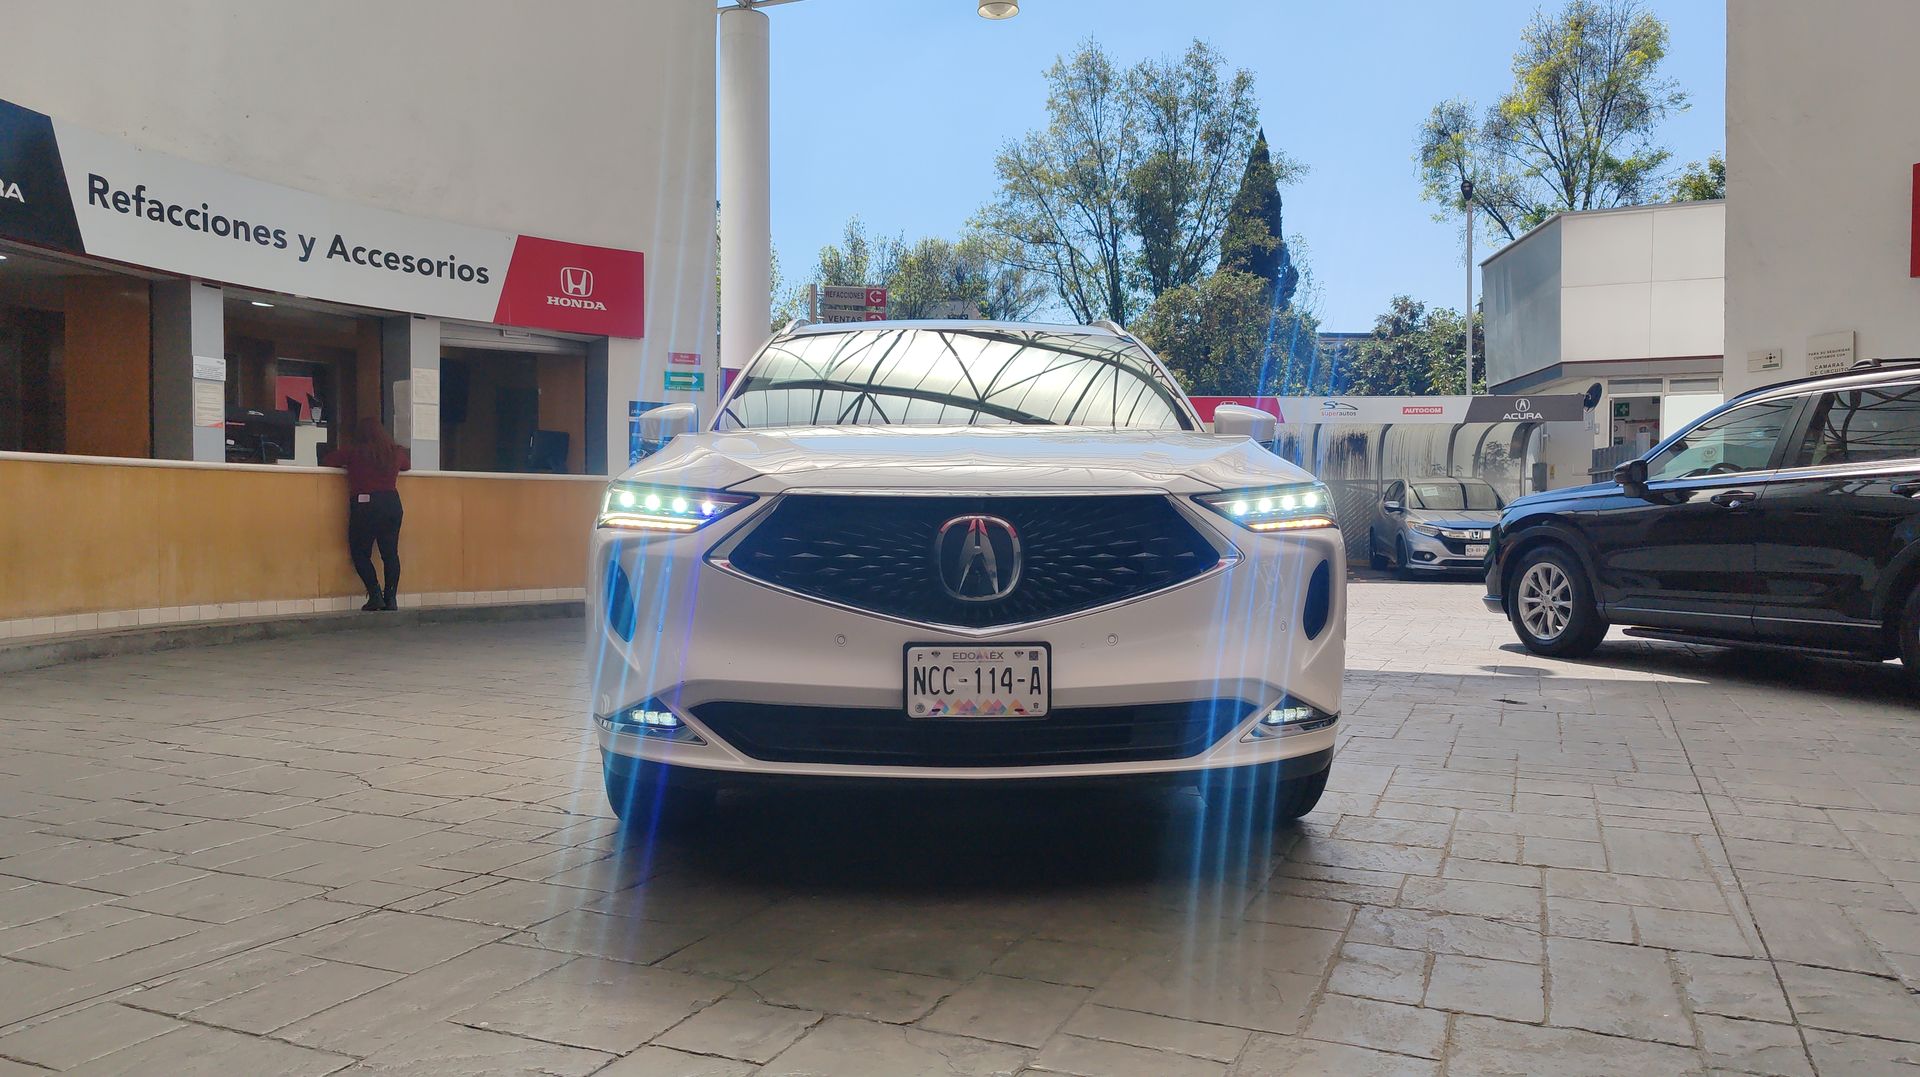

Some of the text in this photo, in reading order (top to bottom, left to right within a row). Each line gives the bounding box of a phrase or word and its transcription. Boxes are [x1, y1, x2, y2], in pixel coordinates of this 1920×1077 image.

[88, 173, 490, 284] Refacciones y Accesorios
[825, 291, 864, 300] REFACCIONES
[546, 295, 607, 310] HONDA
[828, 315, 862, 323] VENTAS
[1815, 362, 1844, 370] CAMARAS
[1502, 412, 1543, 420] ACURA
[917, 653, 923, 662] F
[914, 666, 1041, 695] NCC-114-A
